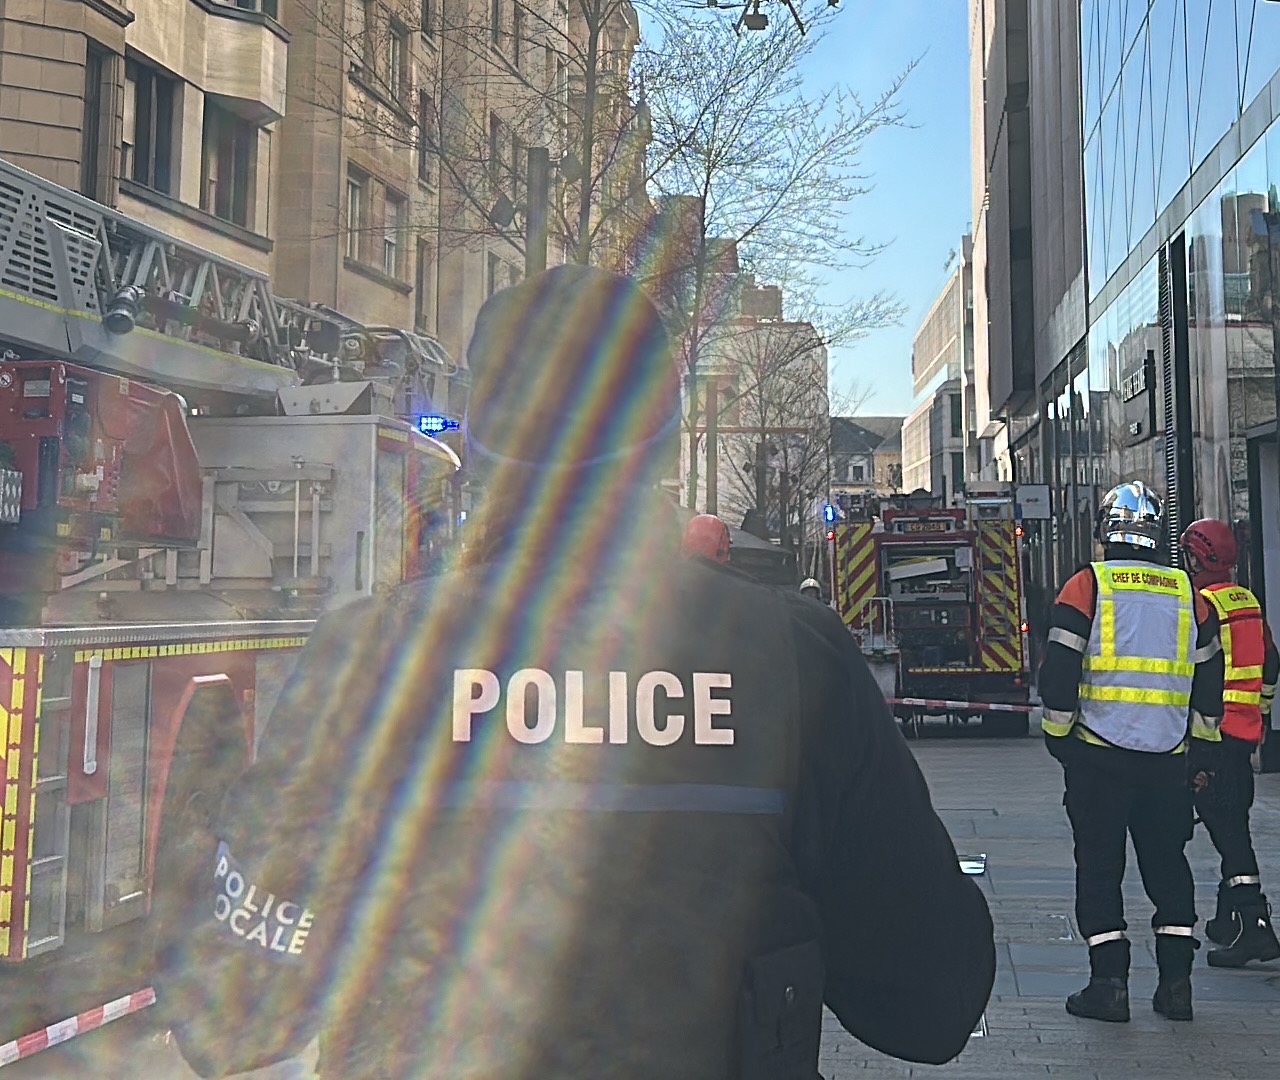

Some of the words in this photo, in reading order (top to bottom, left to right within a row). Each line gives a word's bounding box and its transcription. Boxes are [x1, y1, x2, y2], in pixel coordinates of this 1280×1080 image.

[1111, 572, 1130, 583] CHEF
[1131, 572, 1141, 583] DE
[452, 668, 734, 746] POLICE
[214, 855, 315, 928] POLICE
[214, 894, 310, 954] OCALE
